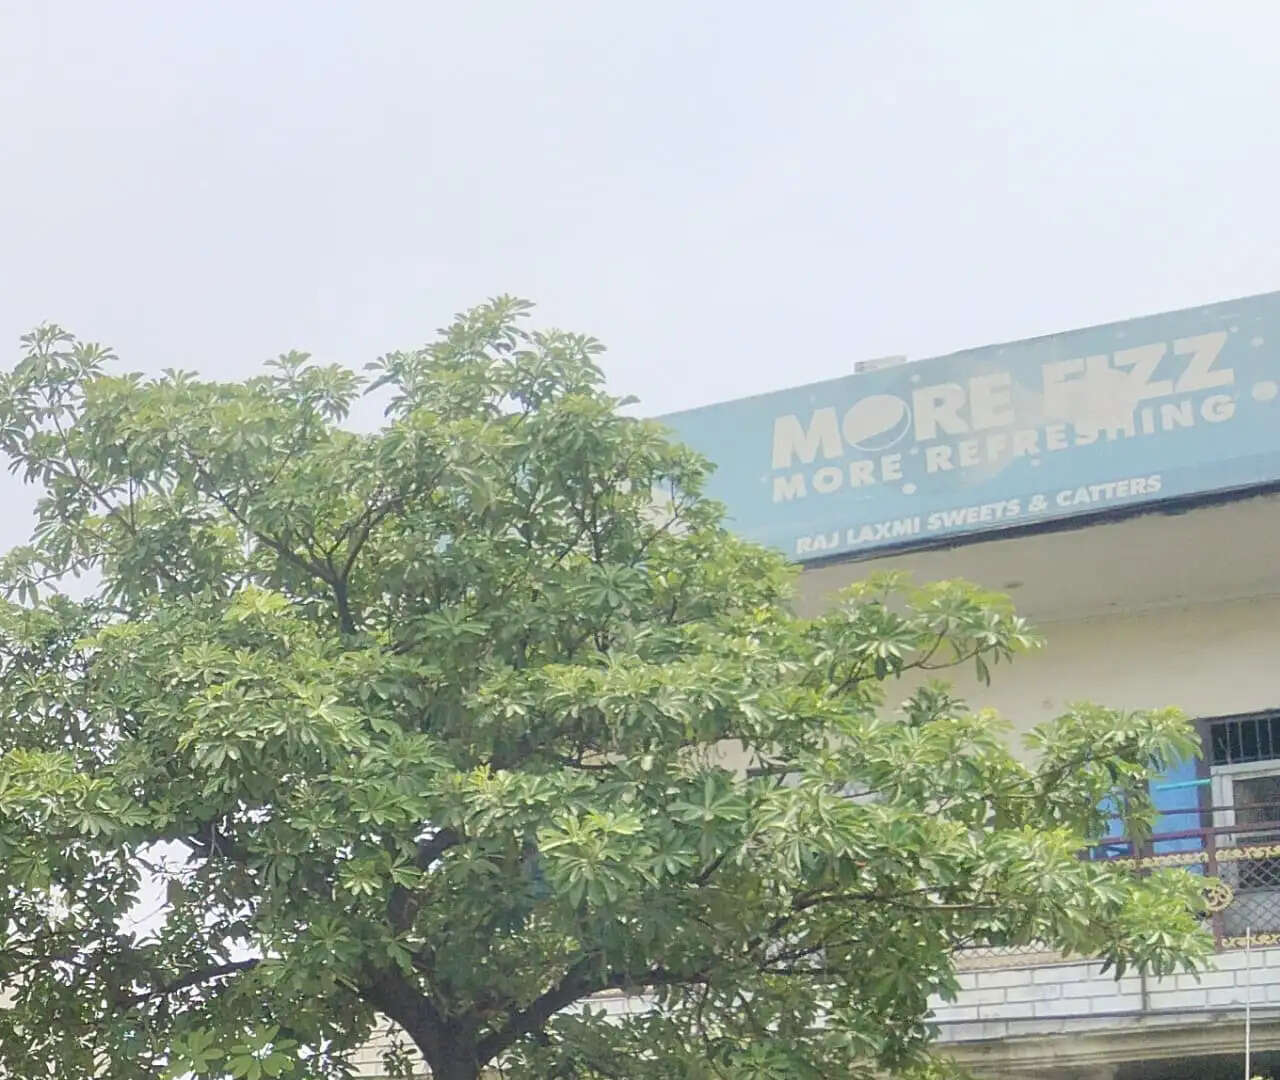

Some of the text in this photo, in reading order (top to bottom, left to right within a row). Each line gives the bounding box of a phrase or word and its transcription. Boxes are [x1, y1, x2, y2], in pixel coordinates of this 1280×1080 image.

[771, 331, 1235, 470] MORE FIZZ
[773, 394, 1237, 503] MORE REFRESHING
[796, 474, 1163, 555] RAJ LAXMI SWEETS & CATTERS
